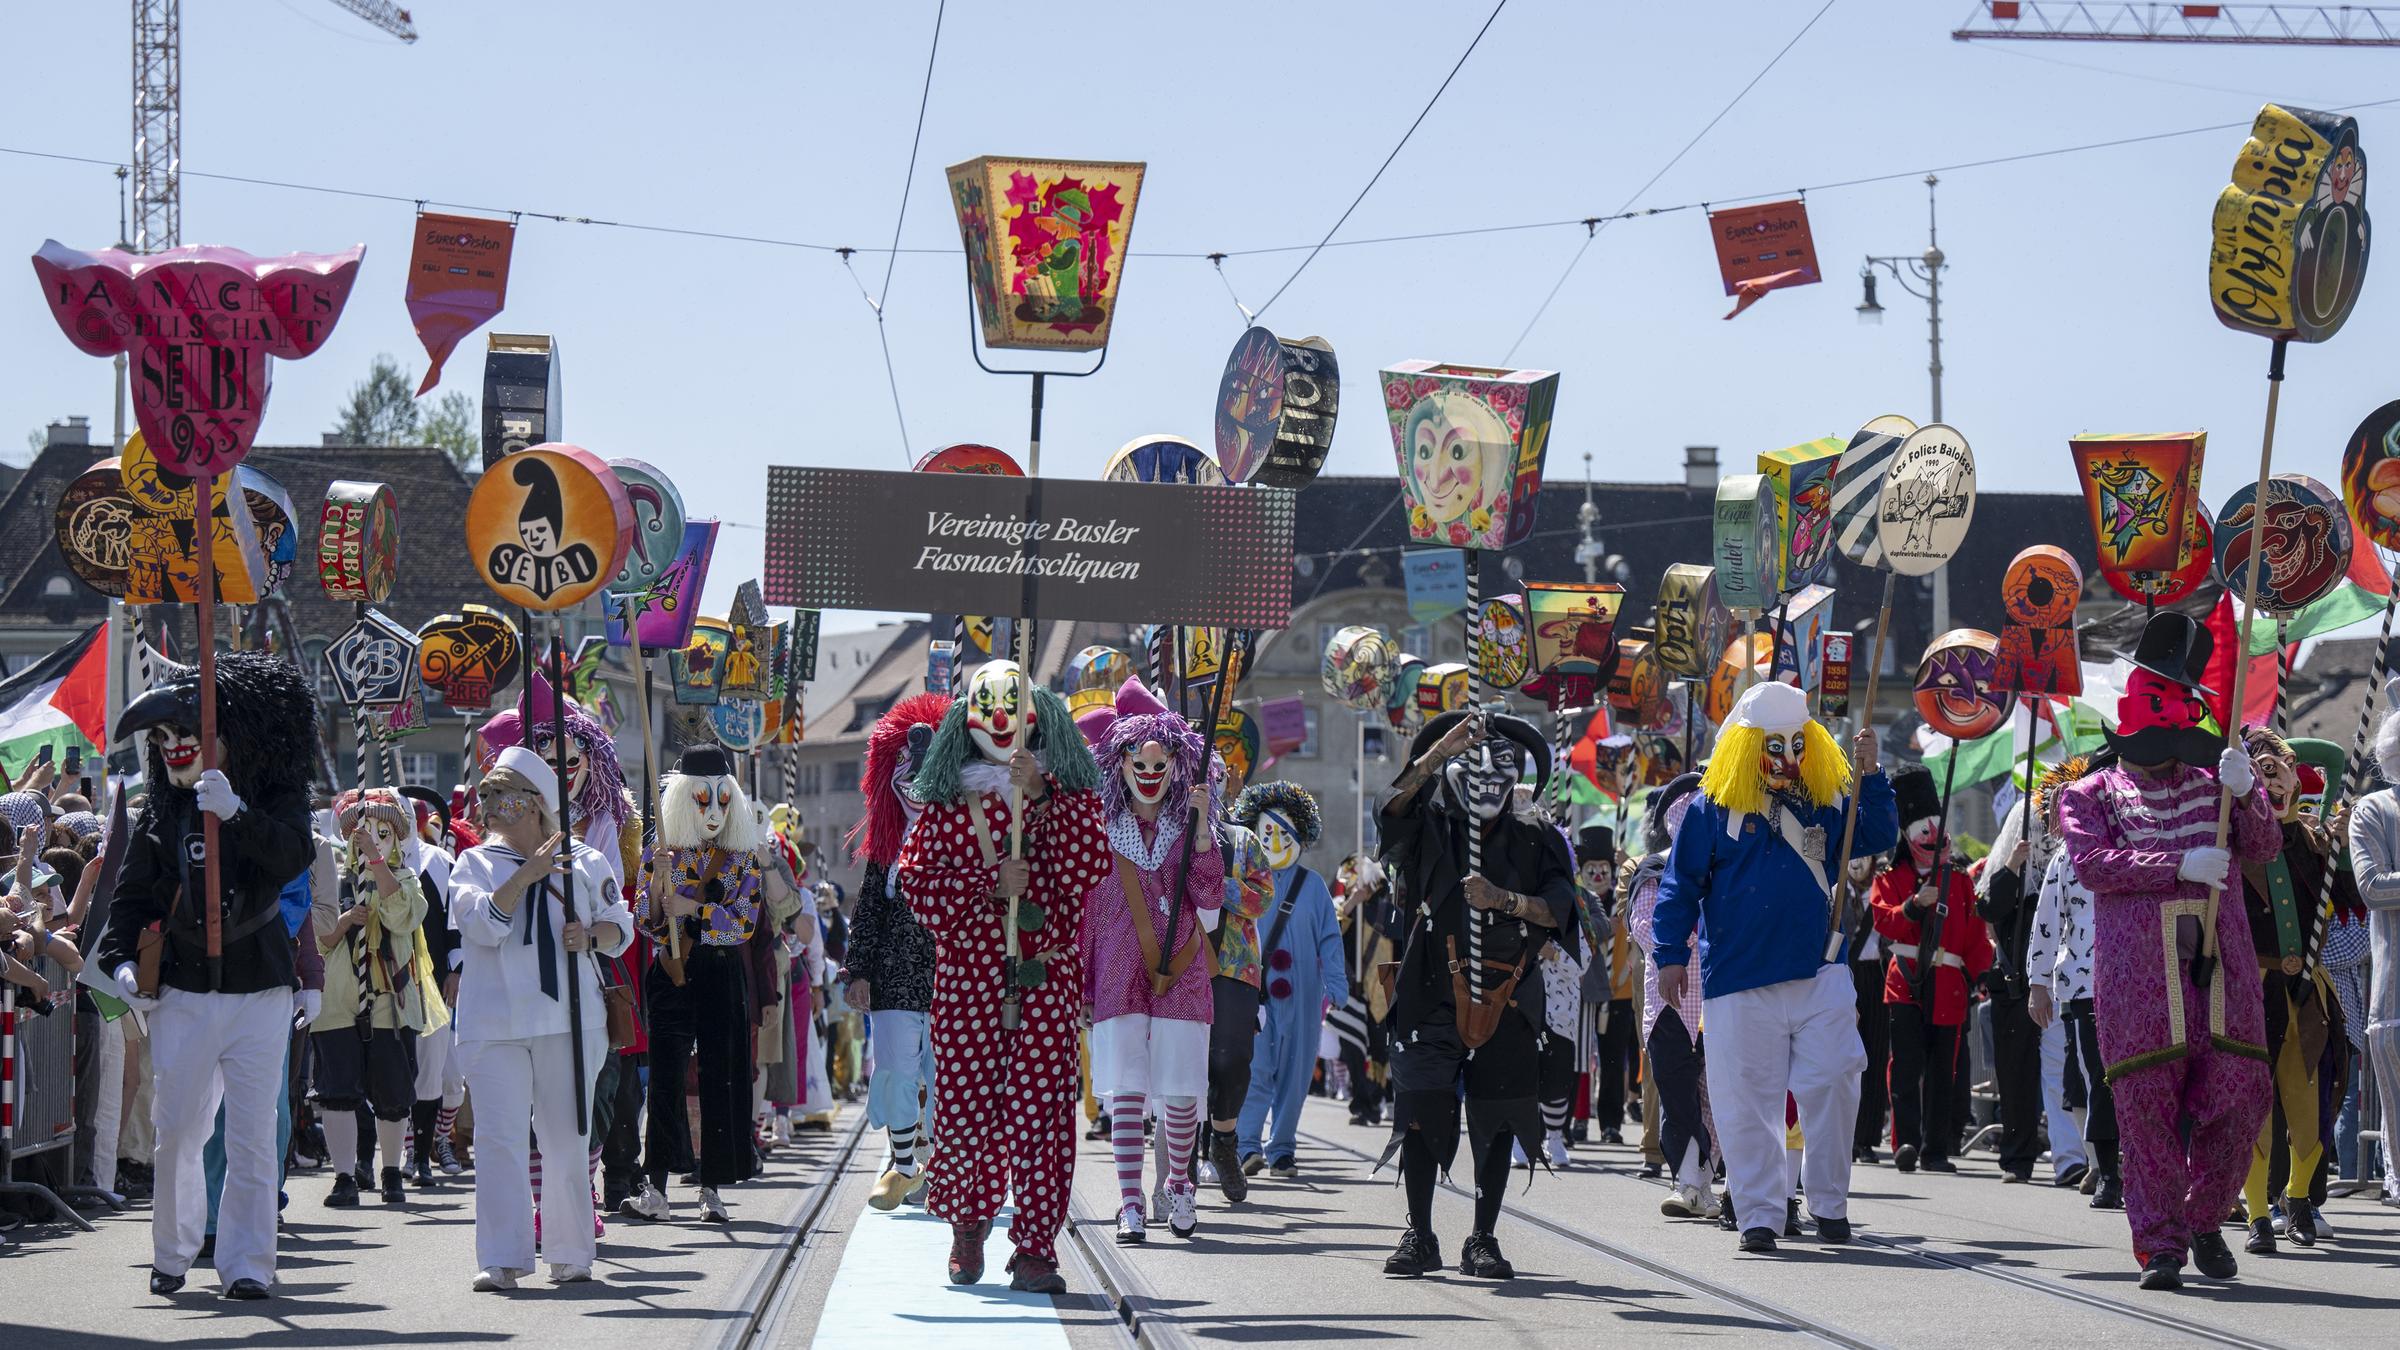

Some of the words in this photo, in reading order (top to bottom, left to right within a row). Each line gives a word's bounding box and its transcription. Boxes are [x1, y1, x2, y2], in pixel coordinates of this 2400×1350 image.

[2221, 128, 2315, 325] Olympia
[76, 307, 322, 348] GSELLSCHAFT
[141, 342, 251, 413] SEIBI
[151, 413, 247, 466] 1933
[1890, 461, 1907, 481] Les
[1908, 443, 1938, 463] Folies
[1939, 442, 1974, 477] Baloises
[1925, 459, 1940, 467] 1990
[322, 505, 344, 564] CLUB
[927, 511, 1051, 546] Vereinigte
[1051, 517, 1141, 545] Basler
[494, 547, 590, 595] SEIBI
[913, 545, 1142, 584] Fasnachtscliquen
[1722, 537, 1752, 592] Gundeli
